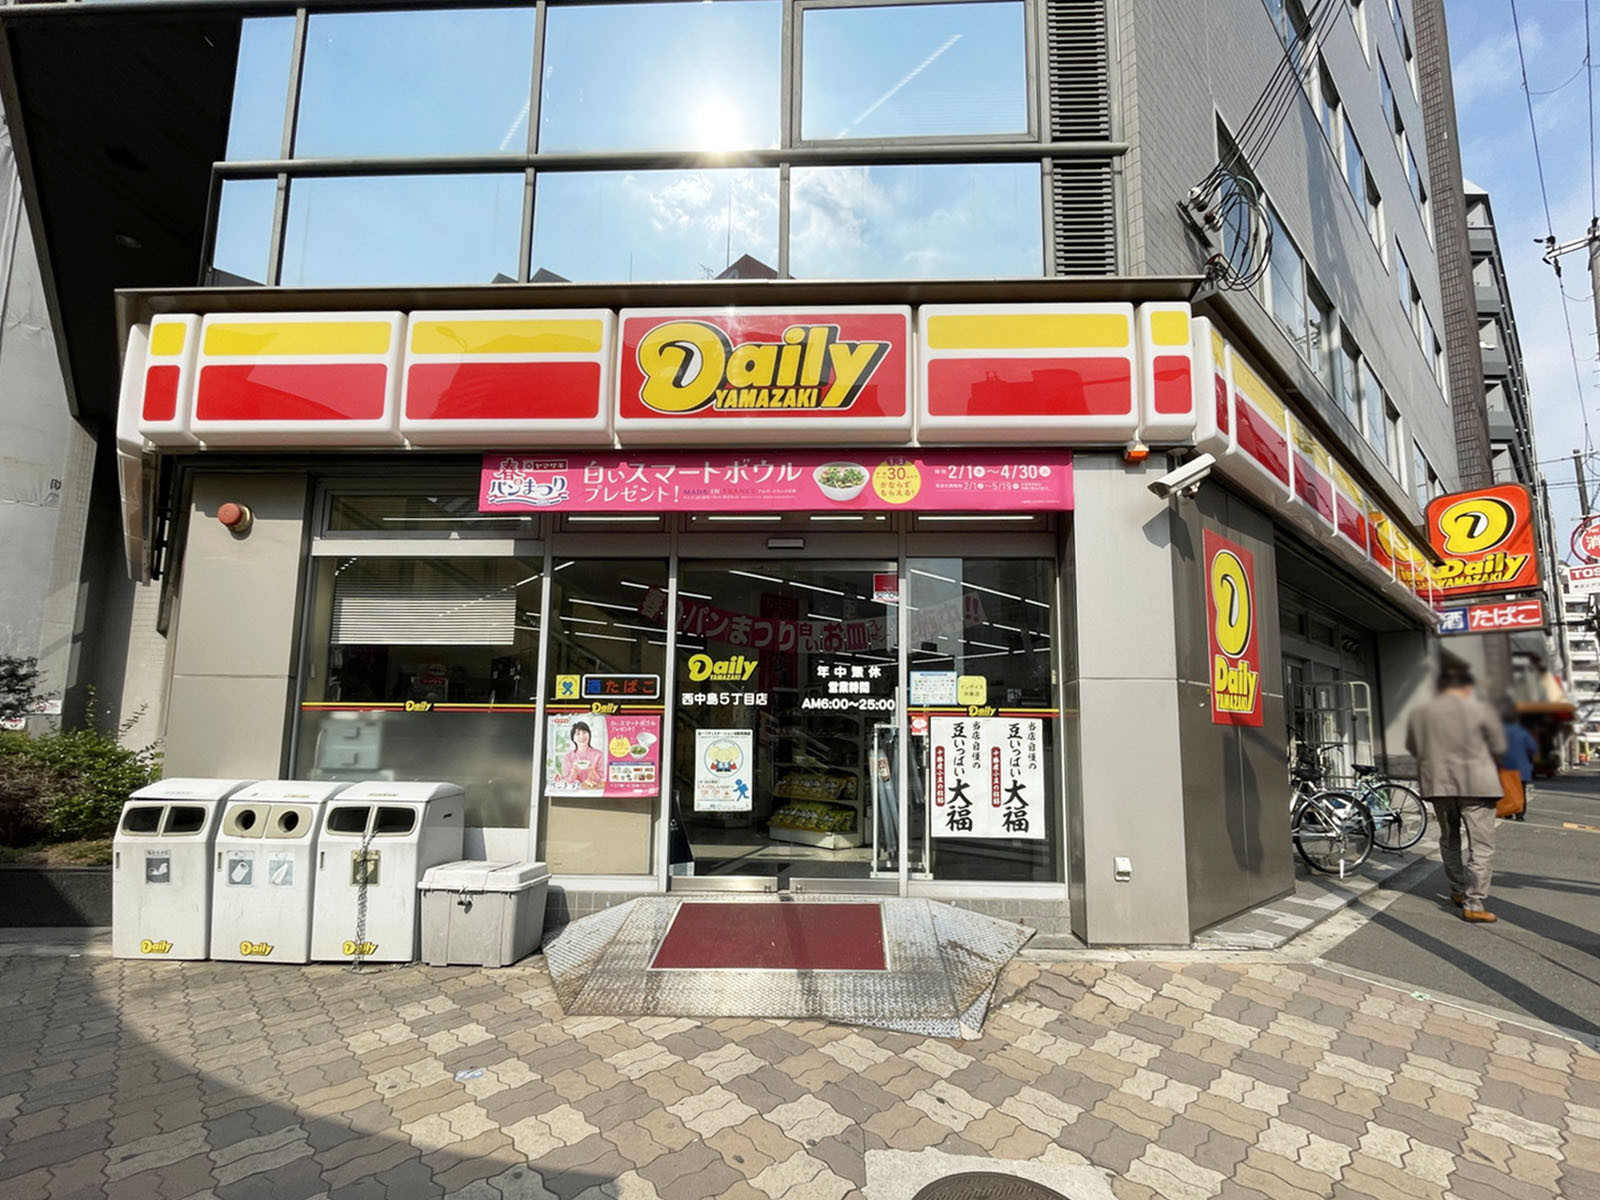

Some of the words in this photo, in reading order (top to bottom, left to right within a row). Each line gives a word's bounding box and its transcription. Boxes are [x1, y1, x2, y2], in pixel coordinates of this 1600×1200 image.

[637, 320, 887, 413] Daily
[715, 388, 821, 409] YAMAZAKI
[584, 459, 802, 485] 白いスマートボウル
[584, 484, 680, 503] プレゼント!
[1430, 553, 1529, 583] Daily
[1440, 573, 1504, 588] YAMAZAKI
[1442, 611, 1464, 631] 酒
[1471, 605, 1540, 627] たばこ
[688, 654, 758, 682] Daily
[816, 665, 882, 679] 年中無休
[605, 679, 656, 694] たばこ
[828, 681, 870, 694] 営業時間
[1215, 655, 1259, 709] Daily
[405, 700, 431, 712] Daily
[591, 702, 619, 713] Daily
[968, 705, 997, 717] Daily
[971, 721, 981, 769] 当店自慢の
[1027, 721, 1037, 770] 当店自慢の
[140, 939, 173, 954] Daily
[239, 941, 274, 956] Daily
